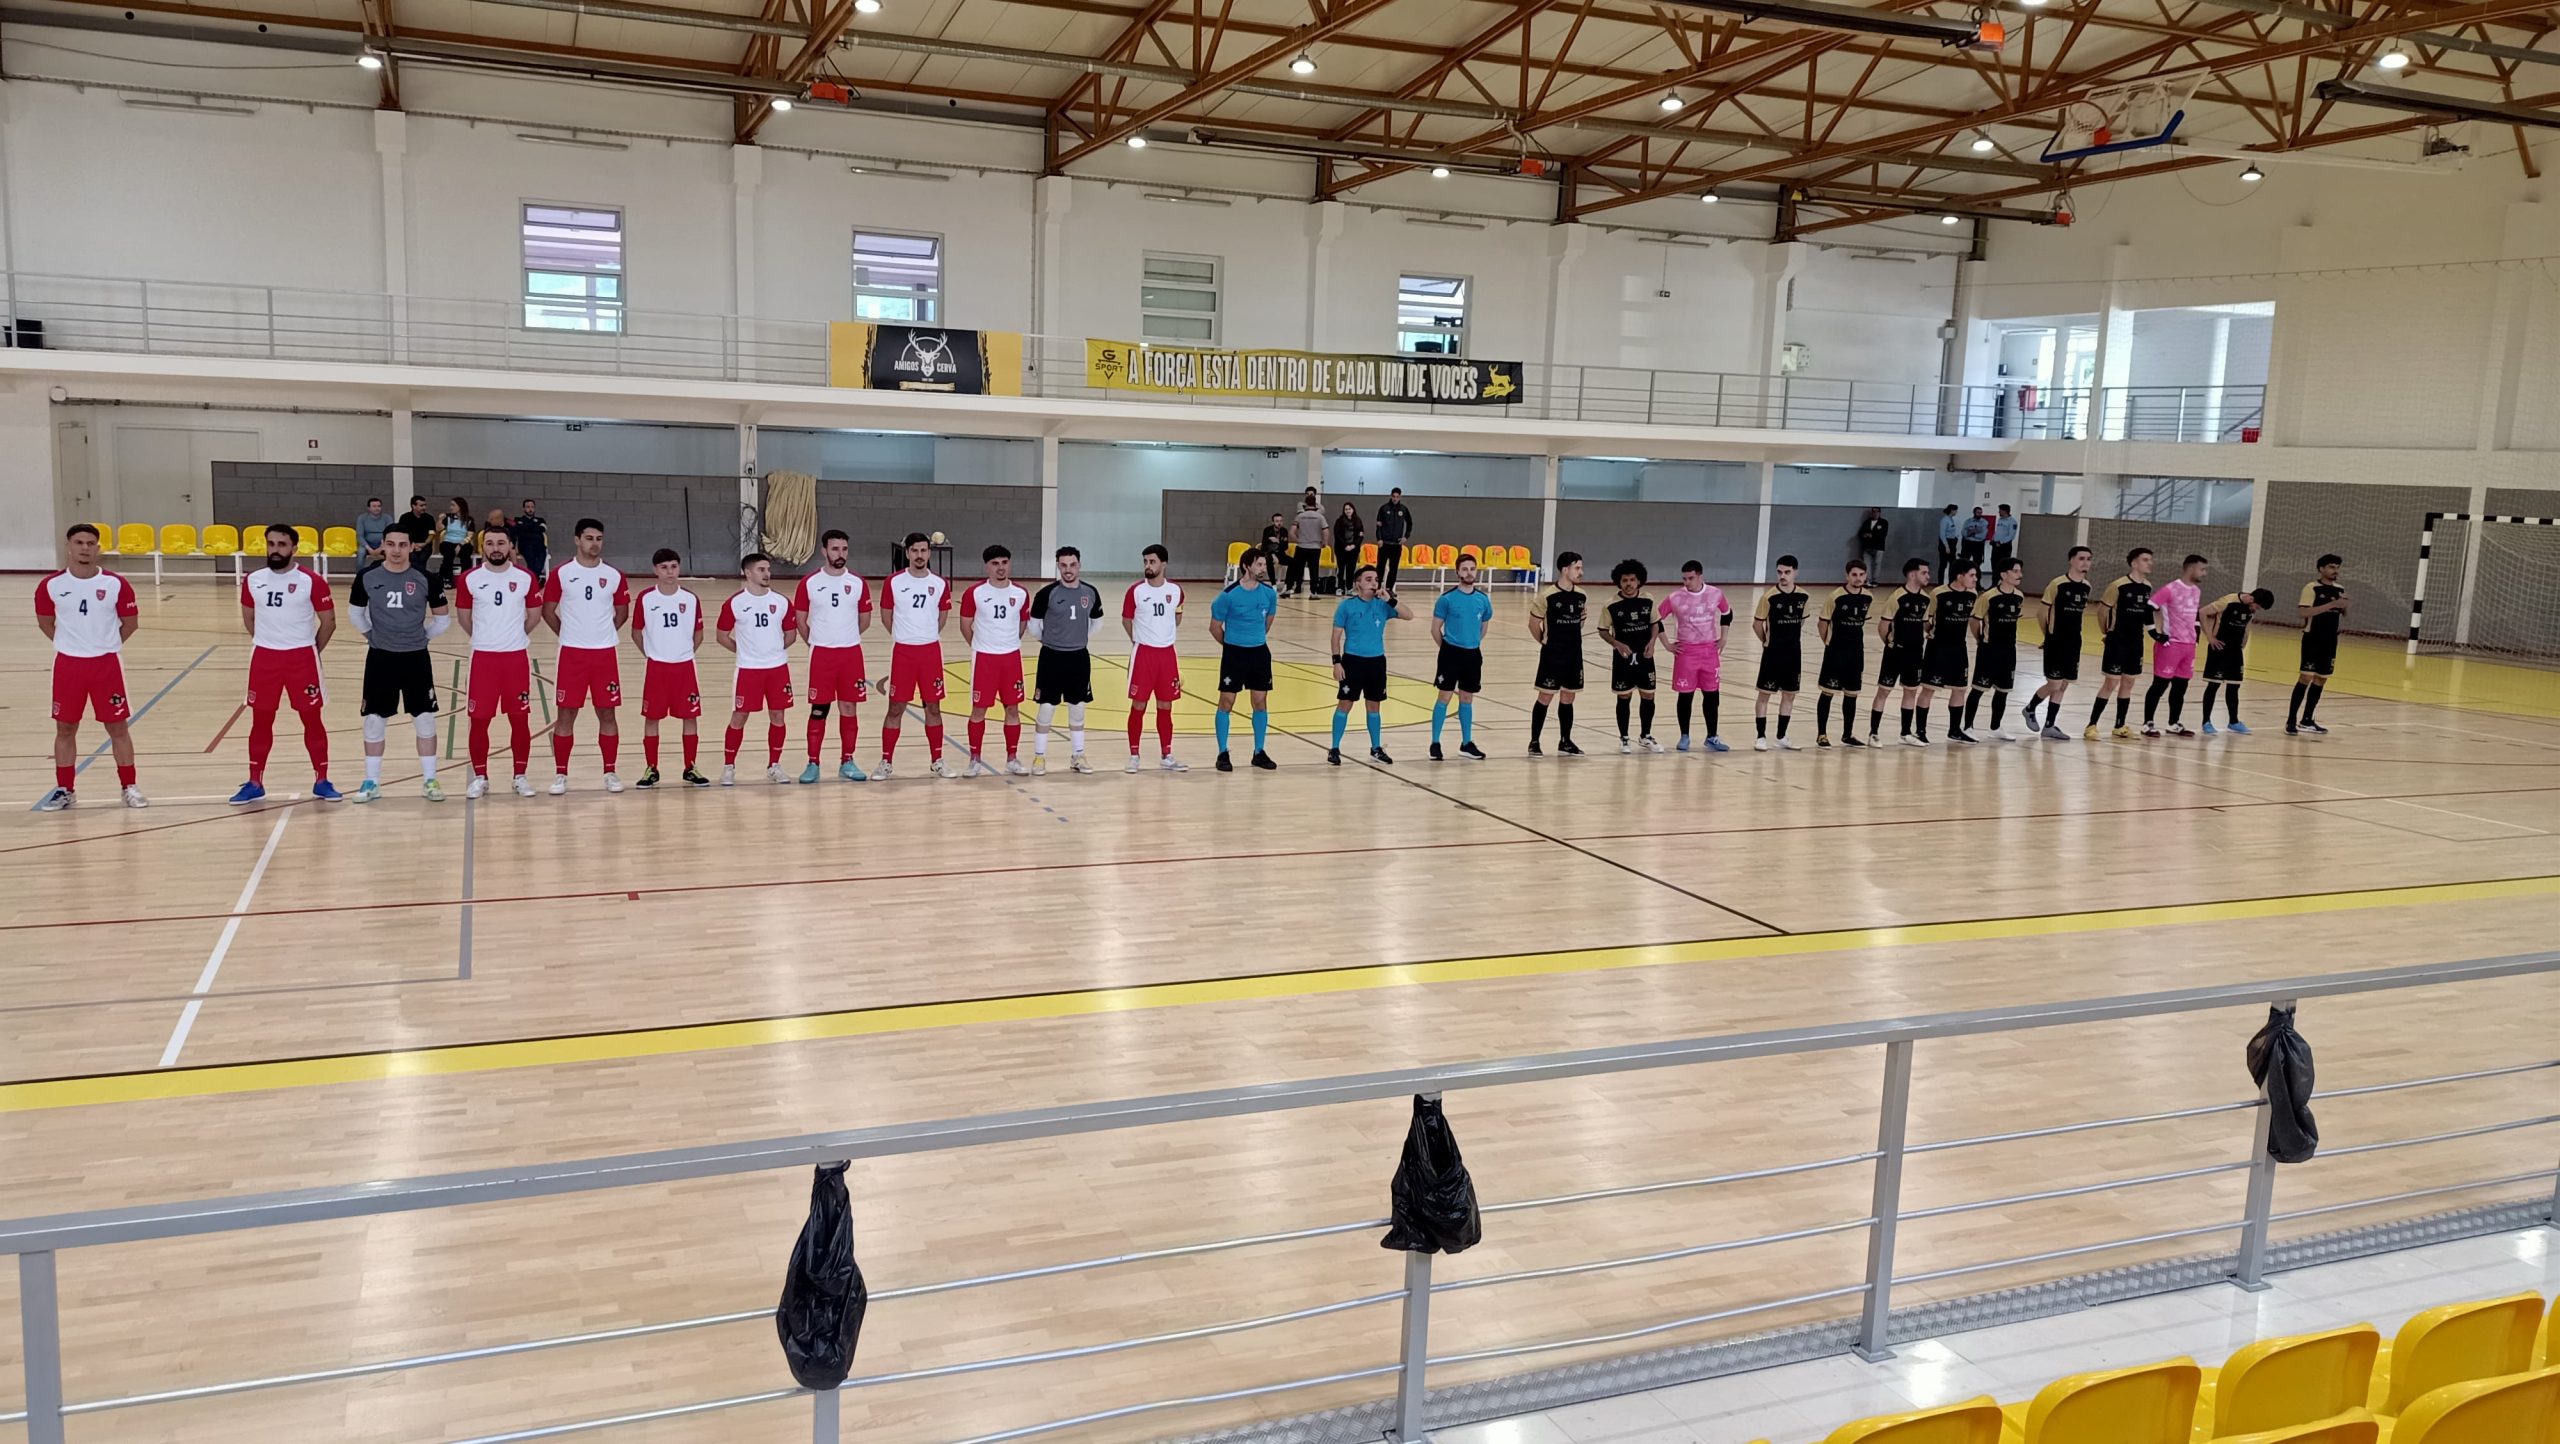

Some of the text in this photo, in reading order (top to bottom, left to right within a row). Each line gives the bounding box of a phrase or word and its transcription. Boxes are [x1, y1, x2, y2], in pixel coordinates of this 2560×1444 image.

[894, 360, 957, 373] AMIGOS CERVA
[1095, 362, 1124, 373] SPORT
[1127, 348, 1479, 400] A FORÇA ESTÁ DENTRO DE CADA UM DE VOCÊS
[266, 591, 283, 608] 15
[387, 591, 404, 608] 21
[494, 591, 503, 606] 9
[585, 585, 593, 600] 8
[831, 593, 839, 607] 5
[79, 599, 88, 616] 4
[912, 594, 926, 609] 27
[994, 605, 1007, 619] 13
[1069, 605, 1077, 620] 1
[1153, 603, 1165, 616] 10
[663, 612, 678, 628] 19
[755, 612, 769, 628] 16
